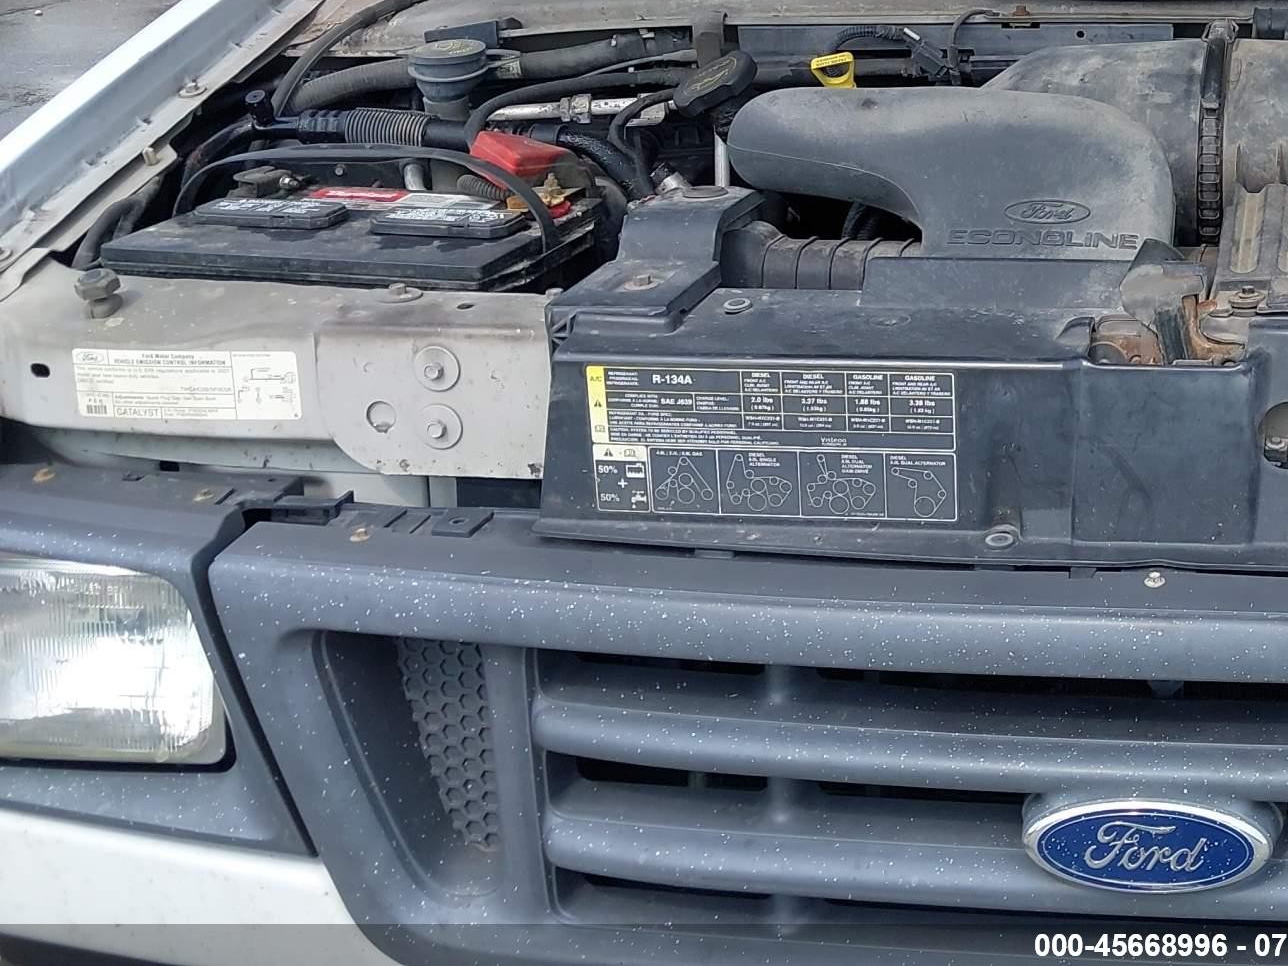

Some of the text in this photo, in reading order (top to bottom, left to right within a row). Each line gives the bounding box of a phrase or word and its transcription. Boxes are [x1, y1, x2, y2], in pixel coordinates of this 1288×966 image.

[1020, 202, 1076, 221] Ford
[946, 229, 1140, 250] ECONOLINE
[652, 373, 693, 385] R-134A
[904, 375, 936, 383] GASOLINE
[116, 408, 159, 417] CATALYST
[598, 465, 619, 474] 50%
[600, 493, 621, 503] 50%
[1084, 821, 1207, 872] Ford
